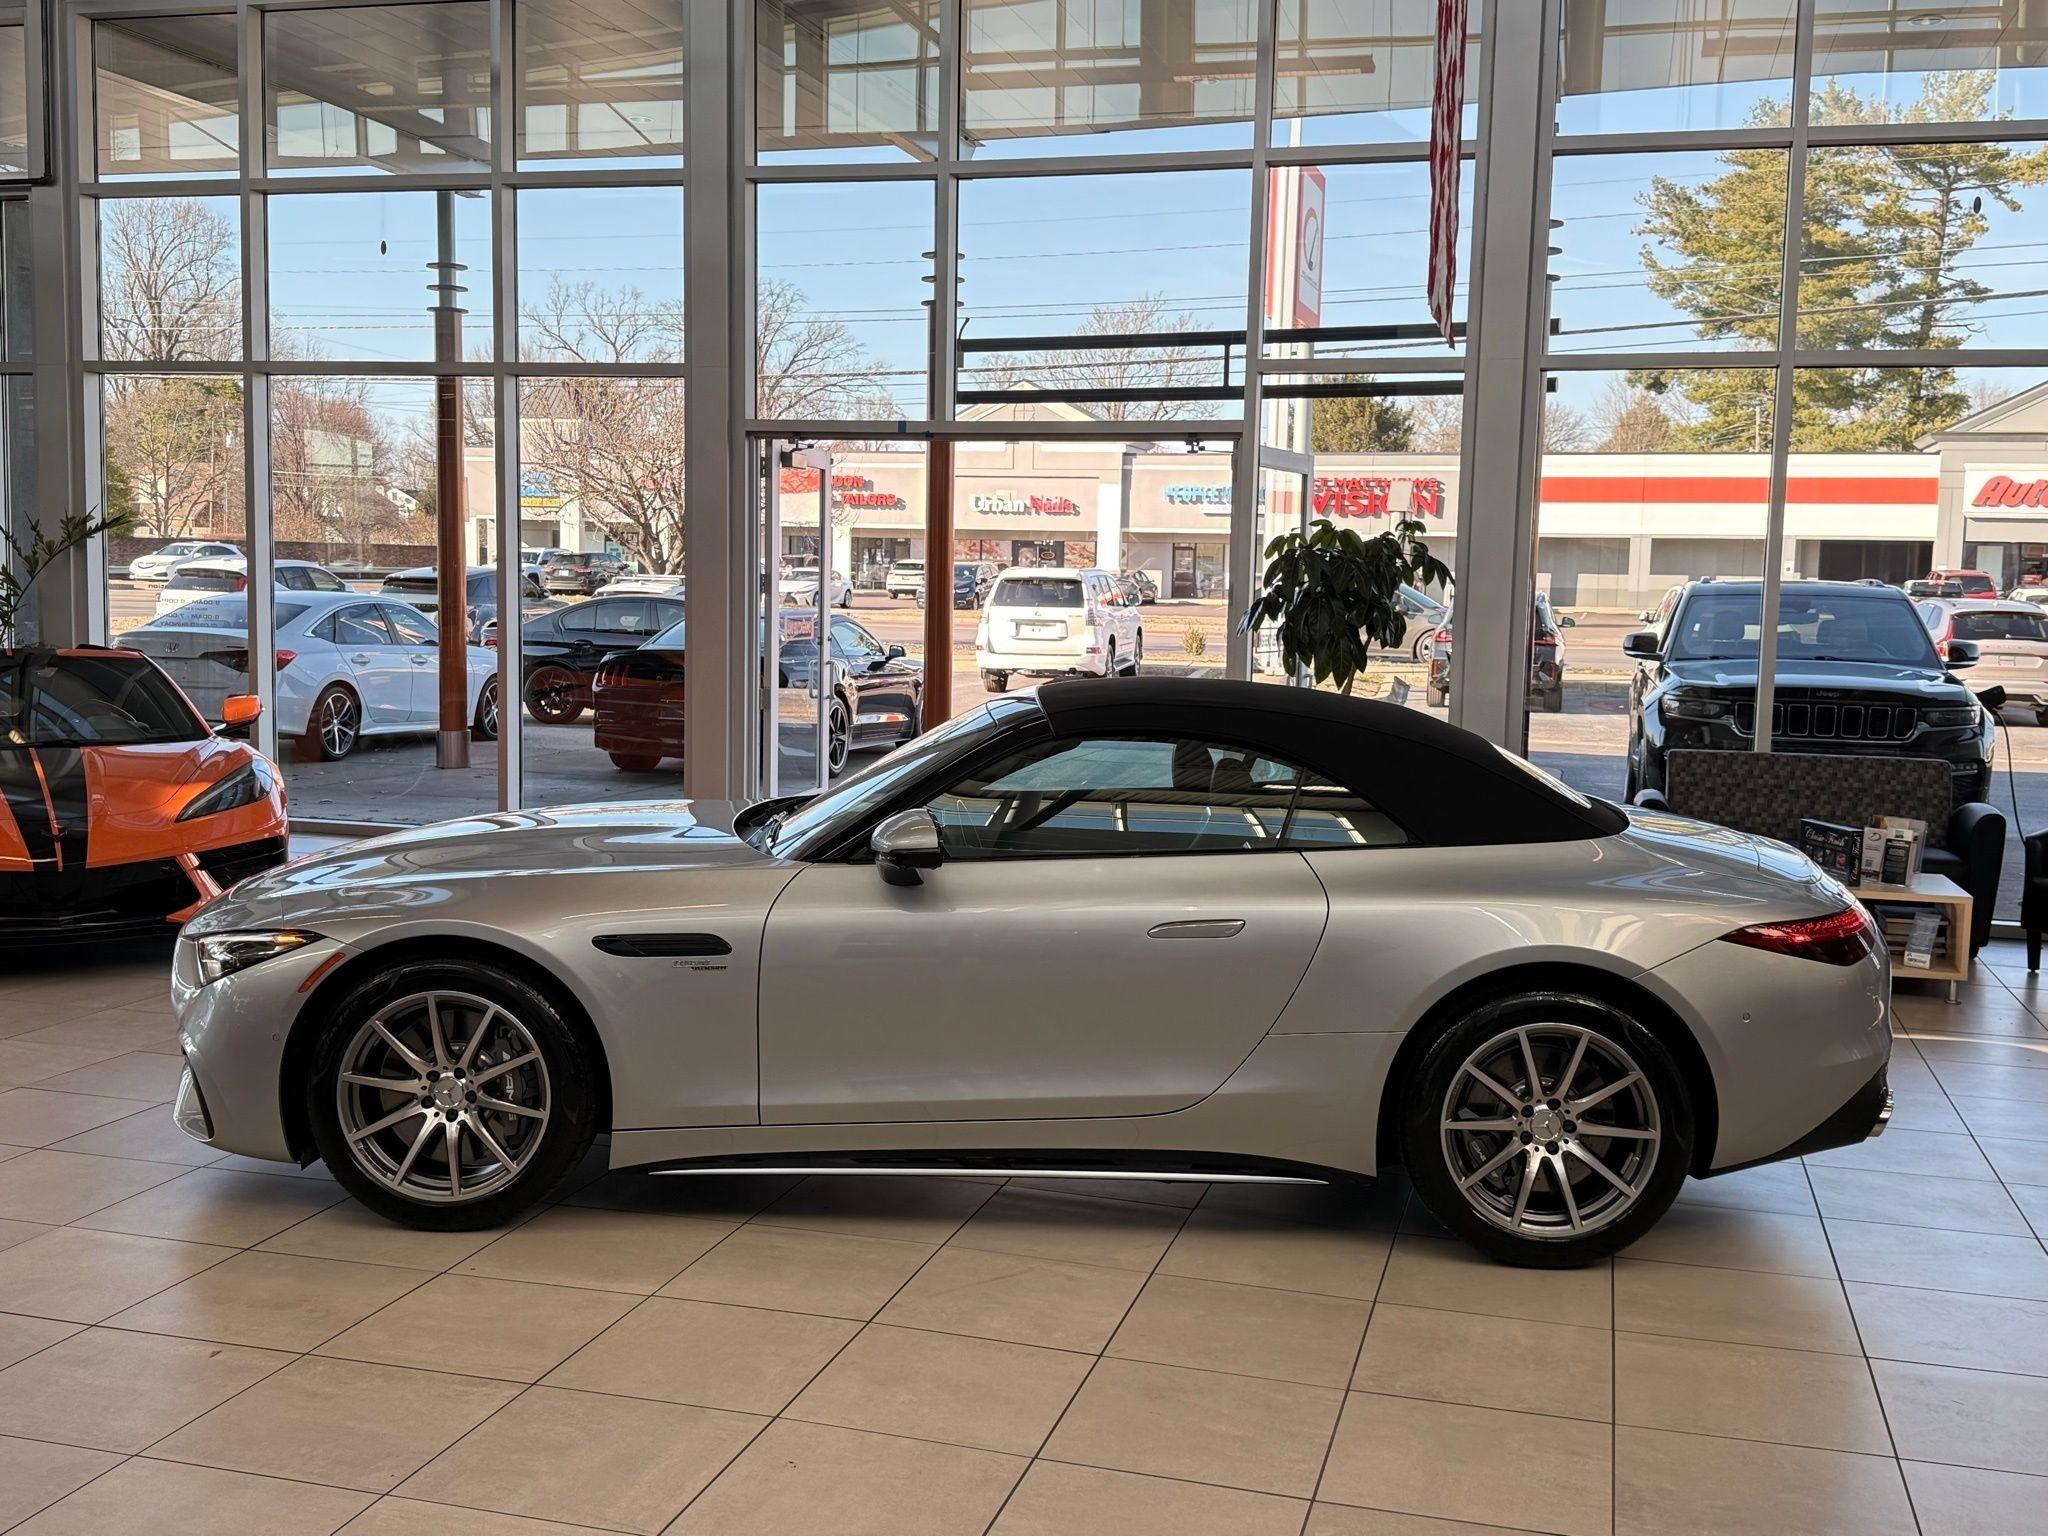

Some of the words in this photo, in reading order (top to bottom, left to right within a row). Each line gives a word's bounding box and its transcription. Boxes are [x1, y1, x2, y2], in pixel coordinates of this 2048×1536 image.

[832, 476, 864, 488] DON
[1333, 477, 1438, 489] MATTHWS
[840, 493, 897, 506] TAILORS
[968, 494, 1025, 512] Urban
[1030, 495, 1075, 513] Nails
